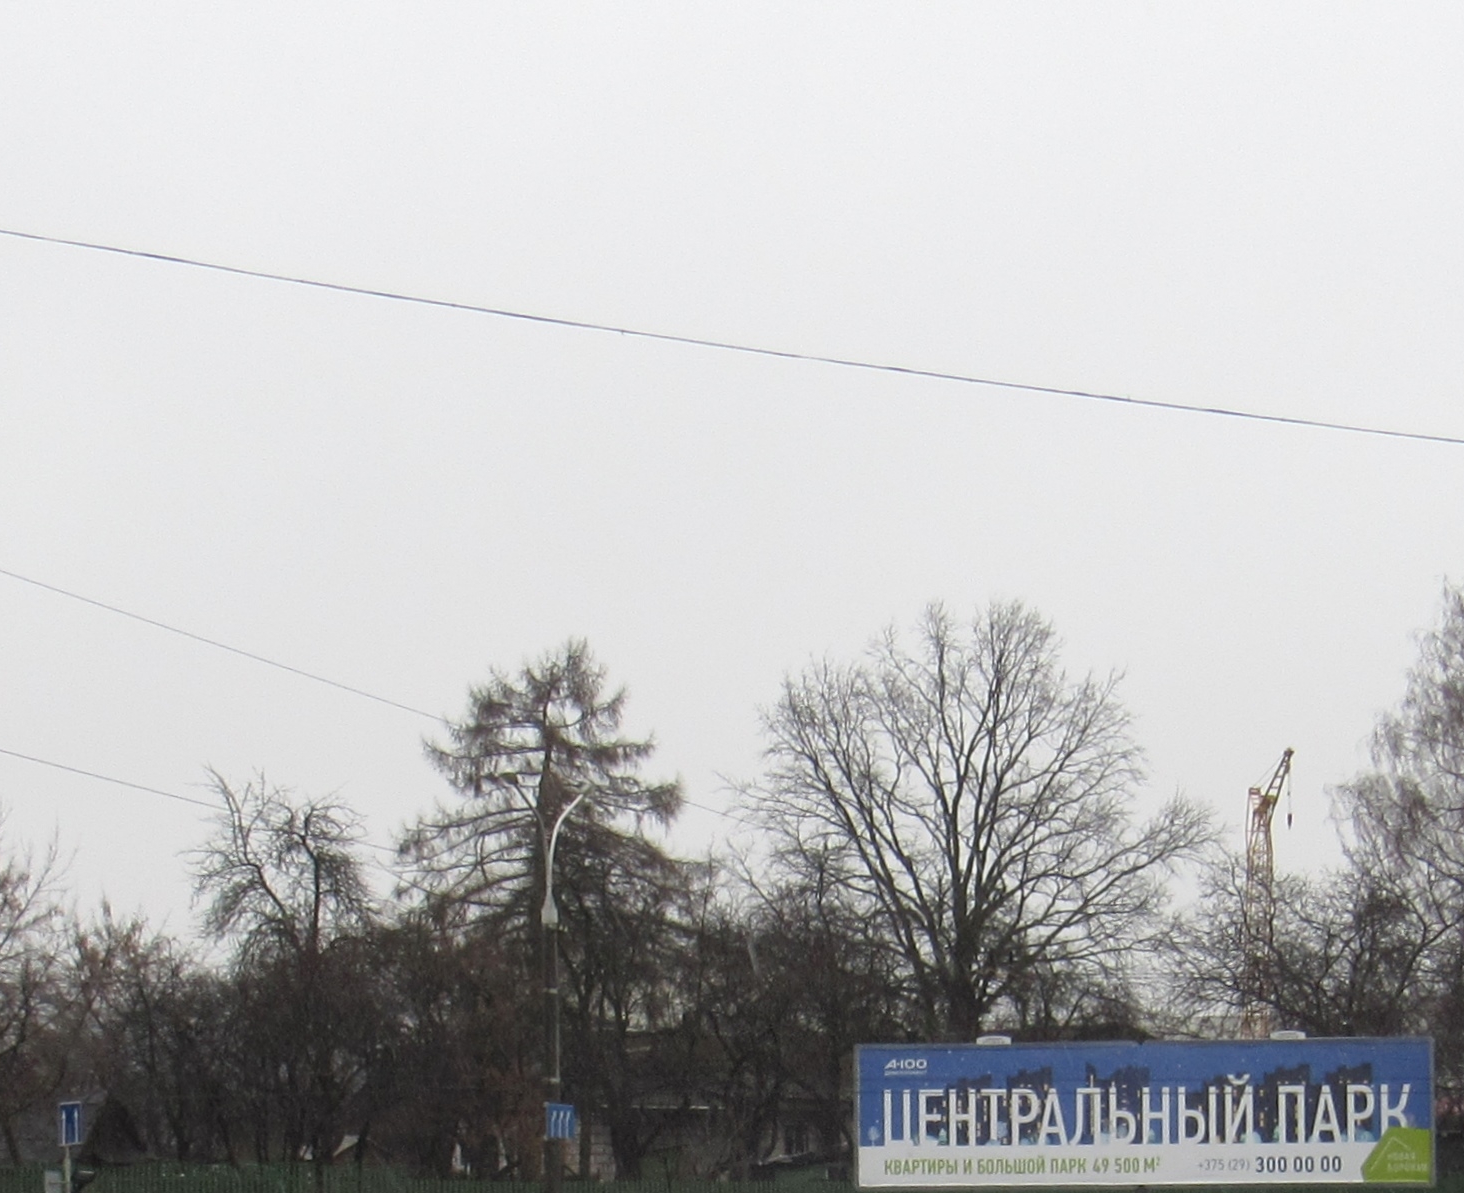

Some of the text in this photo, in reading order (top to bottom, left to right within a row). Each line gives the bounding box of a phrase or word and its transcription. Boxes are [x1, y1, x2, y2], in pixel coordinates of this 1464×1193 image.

[884, 1074, 1411, 1146] ЦЕНТРАЛЬНЫЙ ПАРК
[885, 1158, 958, 1175] КВАРТИРЫ
[963, 1158, 972, 1175] И
[977, 1155, 1046, 1174] БОЛЬШОЙ
[1051, 1157, 1087, 1173] ПАРК
[1092, 1157, 1110, 1173] 49
[1115, 1157, 1140, 1173] 500
[1197, 1155, 1342, 1173] +375 (29) 300 00 00
